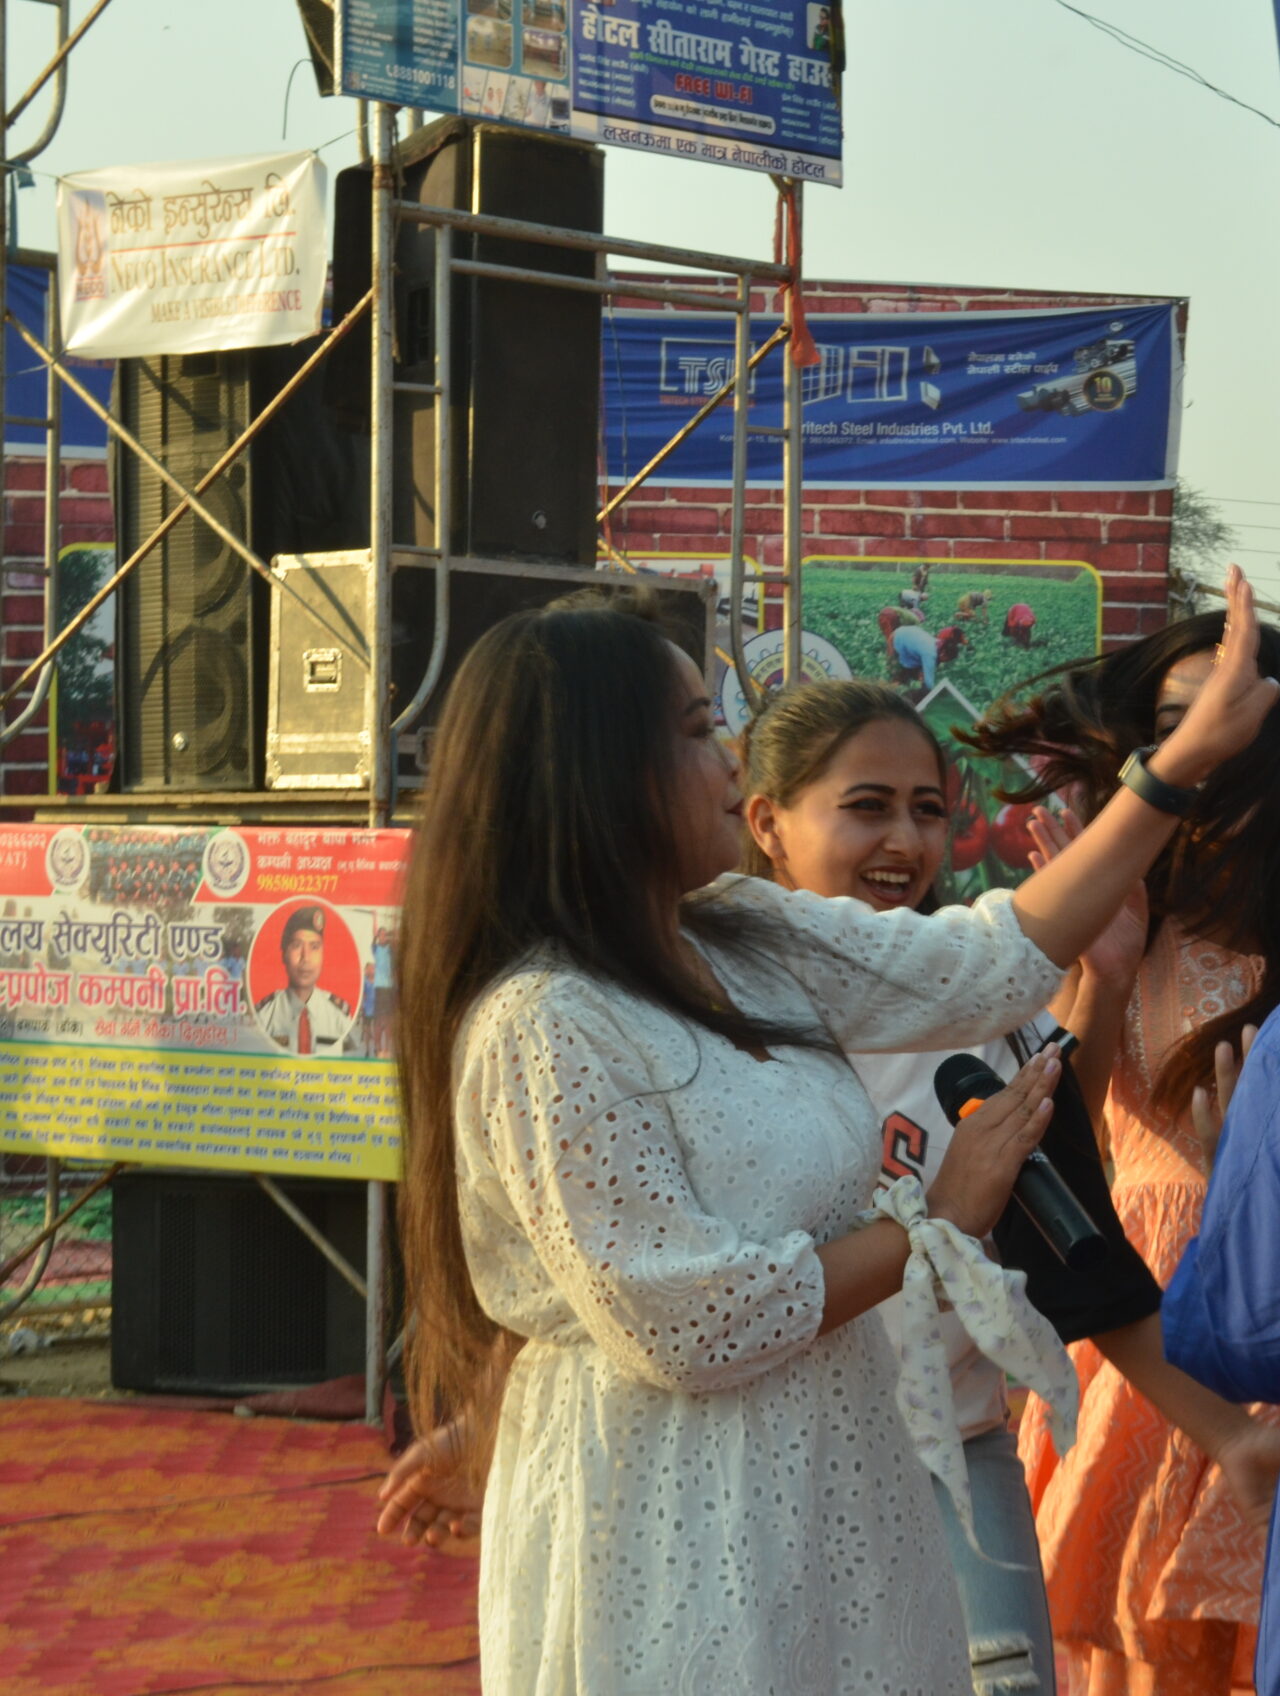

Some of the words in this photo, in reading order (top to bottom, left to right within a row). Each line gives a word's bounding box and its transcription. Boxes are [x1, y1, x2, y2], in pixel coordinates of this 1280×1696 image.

[579, 4, 642, 49] होटल
[647, 18, 733, 69] सीताराम
[738, 35, 781, 78] गेस्ट
[674, 72, 711, 98] FREE
[602, 124, 672, 151] लखनऊमा
[675, 137, 698, 155] एक
[700, 142, 728, 161] मात्र
[731, 143, 788, 173] नेपालीको
[790, 155, 826, 179] होटल
[106, 188, 152, 235] नेको
[163, 180, 254, 239] इन्सुरेन्स
[1093, 376, 1113, 393] 10
[801, 421, 839, 435] ritech
[840, 421, 874, 436] Steel
[876, 422, 939, 436] Industries
[942, 422, 968, 435] Pvt.
[970, 421, 995, 435] Ltd.
[257, 852, 293, 870] कम्पनी
[257, 874, 339, 893] 9858022377
[52, 910, 161, 964] सेक्युरिटी
[168, 924, 223, 957] एण्ड
[78, 963, 165, 1010] कम्पनी
